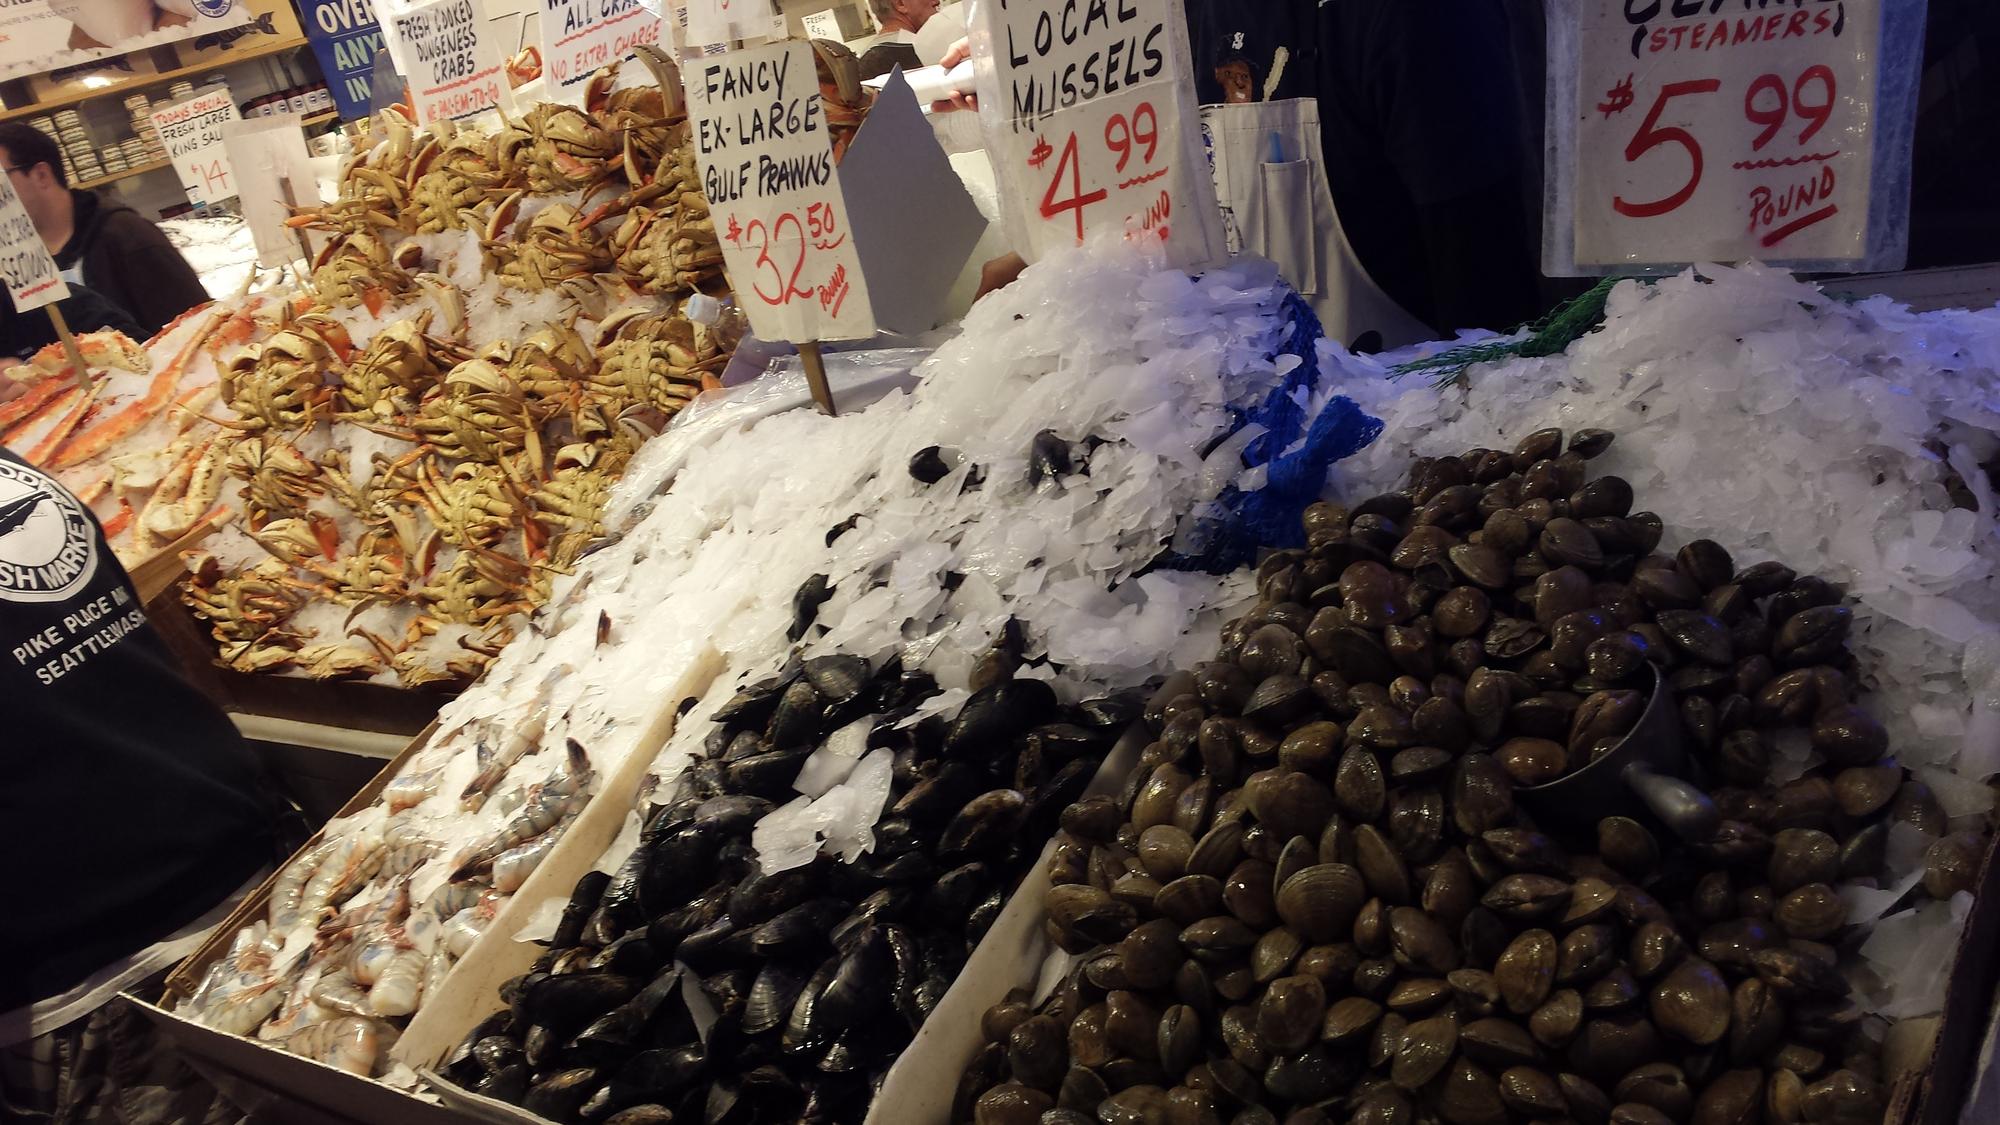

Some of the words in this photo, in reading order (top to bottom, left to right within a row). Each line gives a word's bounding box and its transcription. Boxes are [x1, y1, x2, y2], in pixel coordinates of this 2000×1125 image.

[397, 16, 431, 42] FRESH
[435, 0, 473, 32] COOKED
[416, 23, 477, 62] DUNGENESS
[564, 1, 592, 35] ALL
[1007, 0, 1137, 69] LOCAL
[1632, 2, 1844, 59] (STEAMERS)
[433, 51, 475, 84] CRABS
[550, 59, 567, 83] NO
[575, 42, 608, 73] EXTRA
[614, 18, 661, 57] CHARGE
[705, 51, 789, 104] FANCY
[193, 96, 229, 113] SPECIAL
[345, 76, 371, 102] IN
[1013, 23, 1163, 134] MUSSELS
[162, 122, 195, 141] FRESH
[200, 108, 231, 129] LARGE
[1745, 65, 1836, 151] 99
[172, 138, 197, 158] KING
[1105, 102, 1158, 173] 99
[706, 161, 751, 205] GULF
[759, 149, 831, 197] PRAWNS
[1748, 166, 1836, 232] POUND
[807, 203, 834, 237] 50
[38, 503, 88, 590] MARKET
[12, 625, 64, 666] PIKE
[63, 596, 112, 634] PLACE
